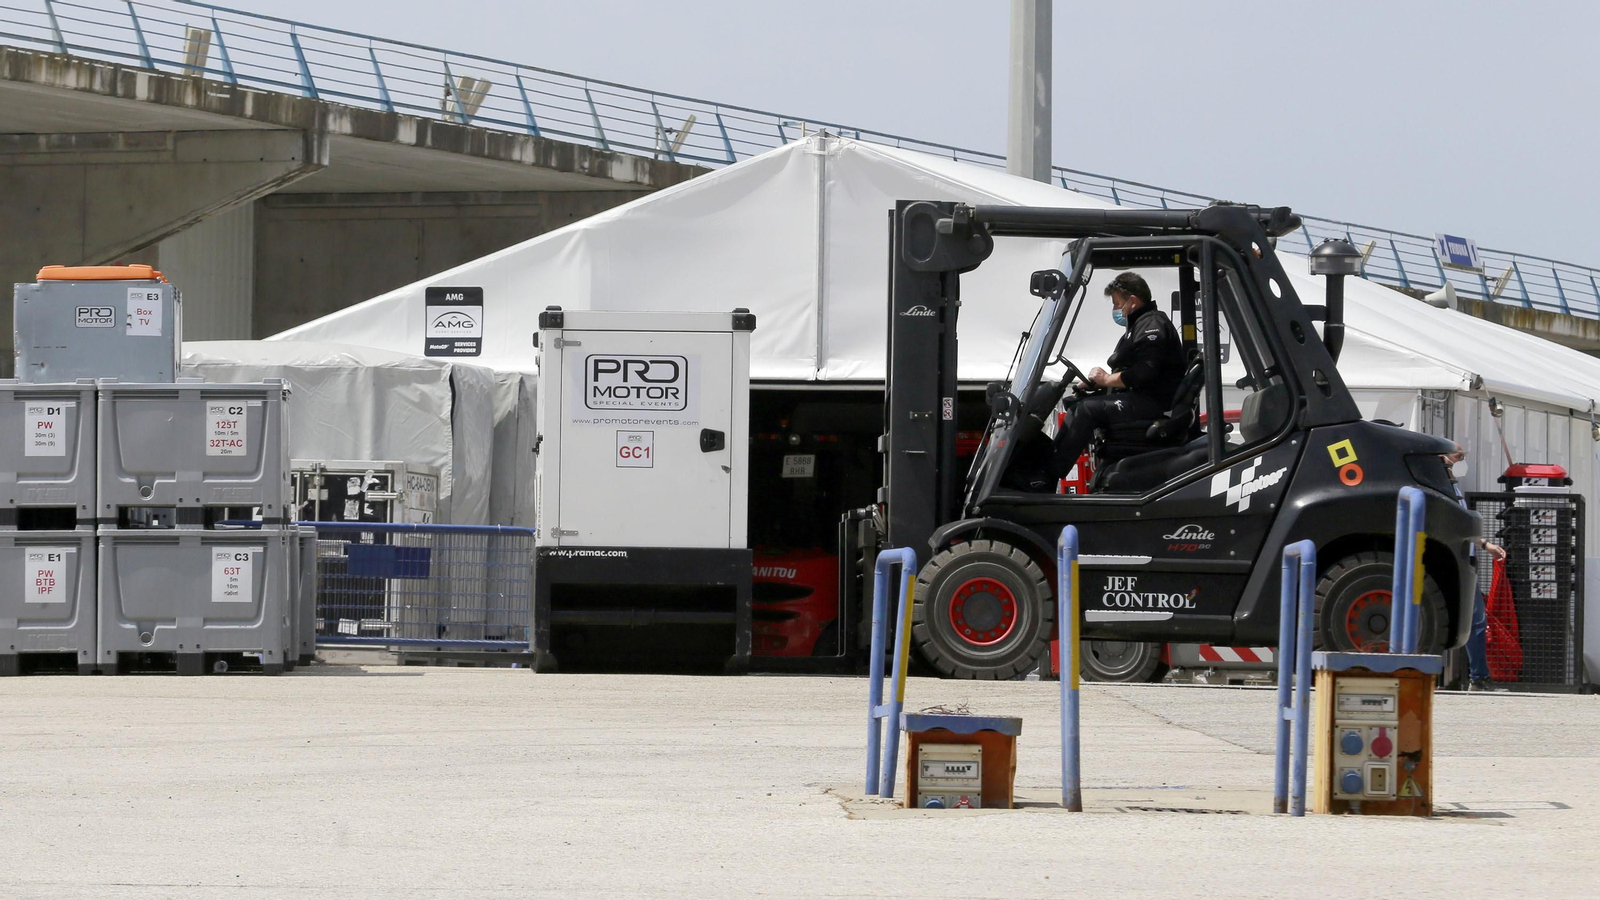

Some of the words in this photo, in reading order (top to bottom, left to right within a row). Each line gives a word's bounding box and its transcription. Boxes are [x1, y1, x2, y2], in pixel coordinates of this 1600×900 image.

[78, 308, 112, 317] PRO
[900, 305, 936, 316] Linde
[593, 359, 680, 383] PRO
[593, 386, 680, 400] MOTOR
[228, 407, 243, 415] C2
[572, 418, 699, 426] www.promotorevents.com
[619, 446, 650, 458] GC1
[793, 457, 811, 465] 5868
[1163, 524, 1215, 540] Linde
[234, 553, 249, 561] C3
[752, 566, 796, 578] ANITOU
[1104, 576, 1138, 591] JEF
[1102, 592, 1196, 609] CONTROL
